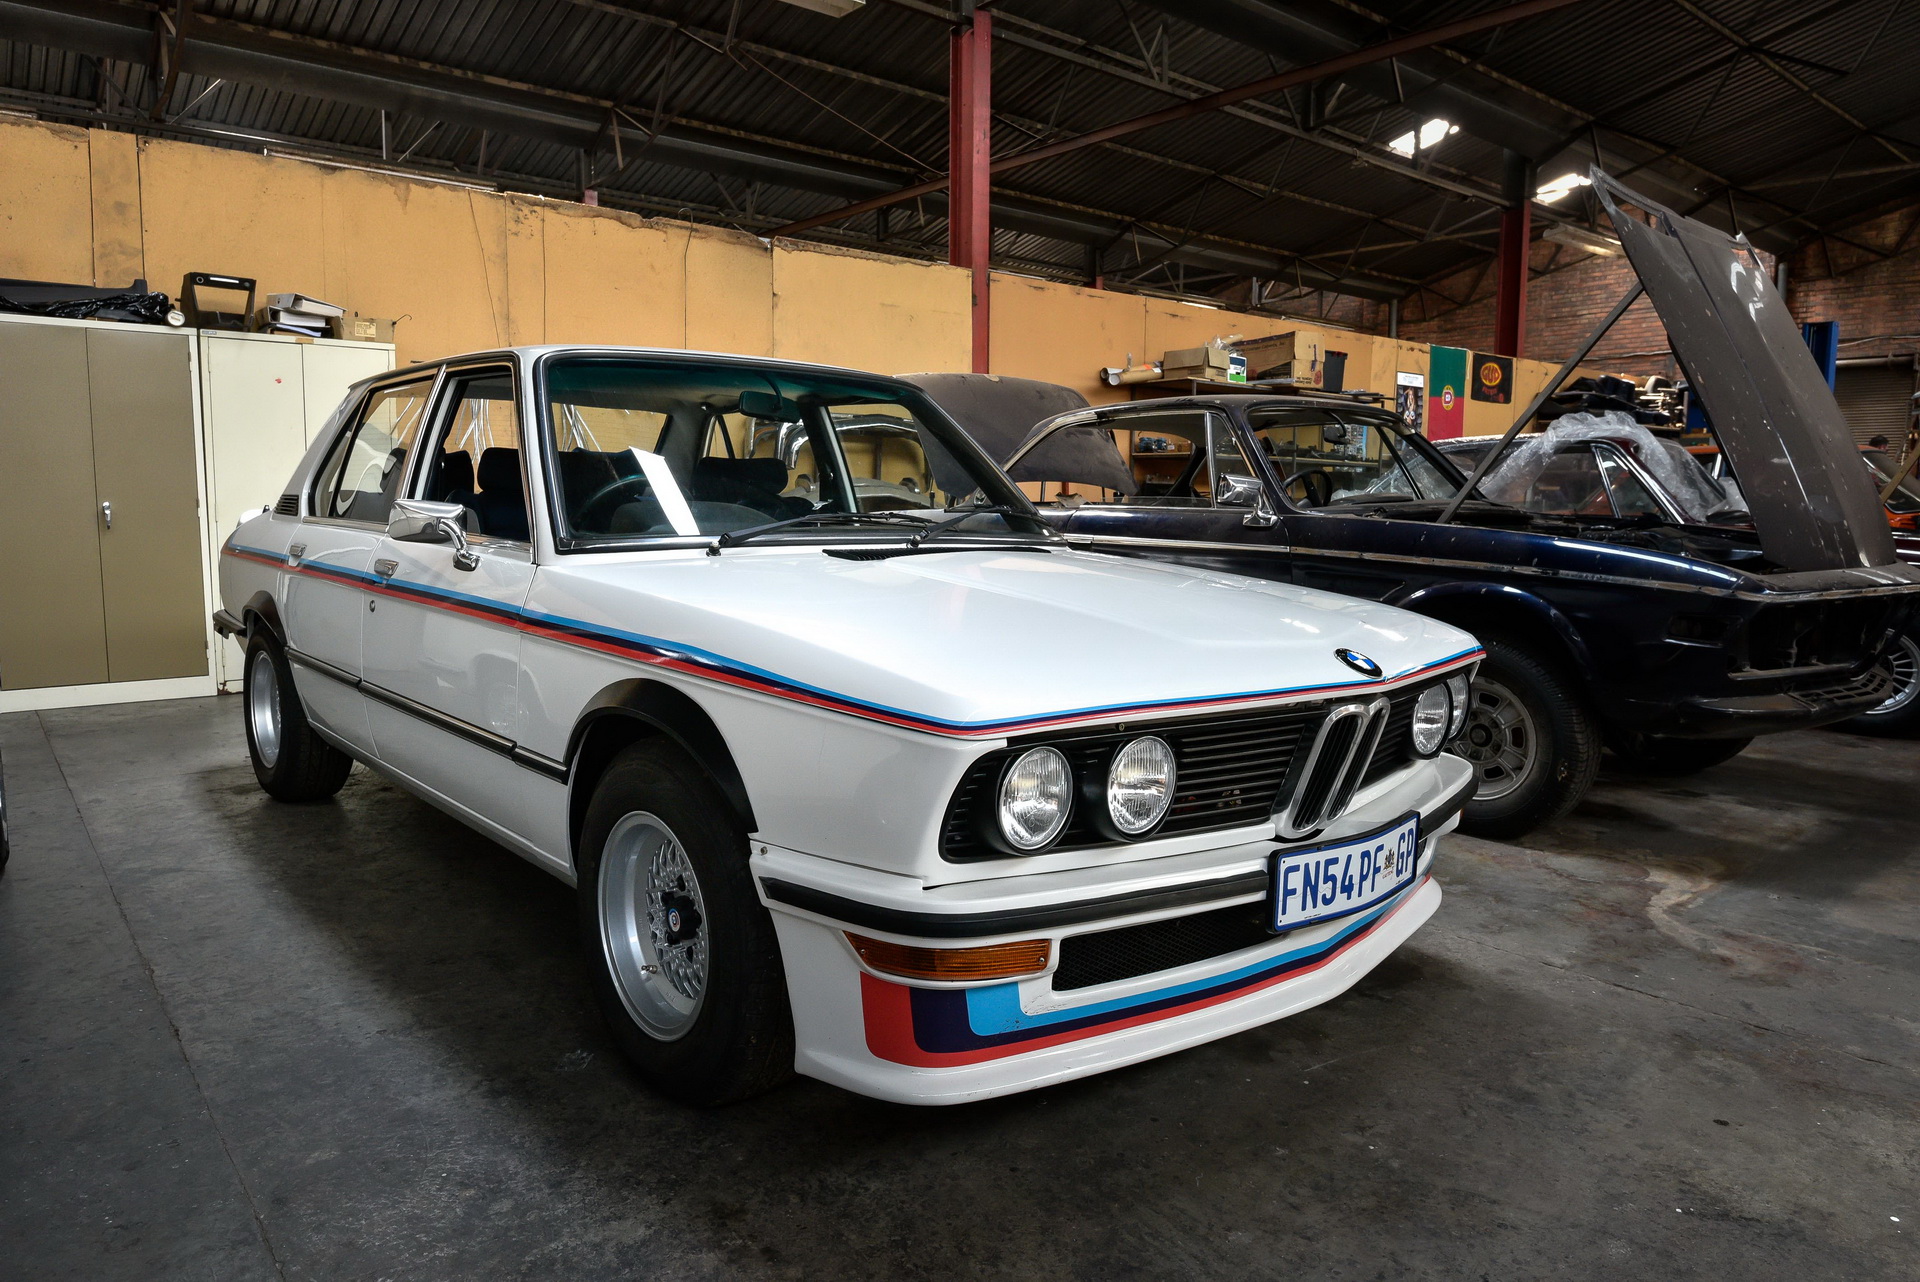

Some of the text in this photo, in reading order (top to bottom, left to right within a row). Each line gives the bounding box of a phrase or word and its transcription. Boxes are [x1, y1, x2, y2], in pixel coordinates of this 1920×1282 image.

[1482, 364, 1501, 384] GUD
[1281, 827, 1415, 916] FN54PF GP
